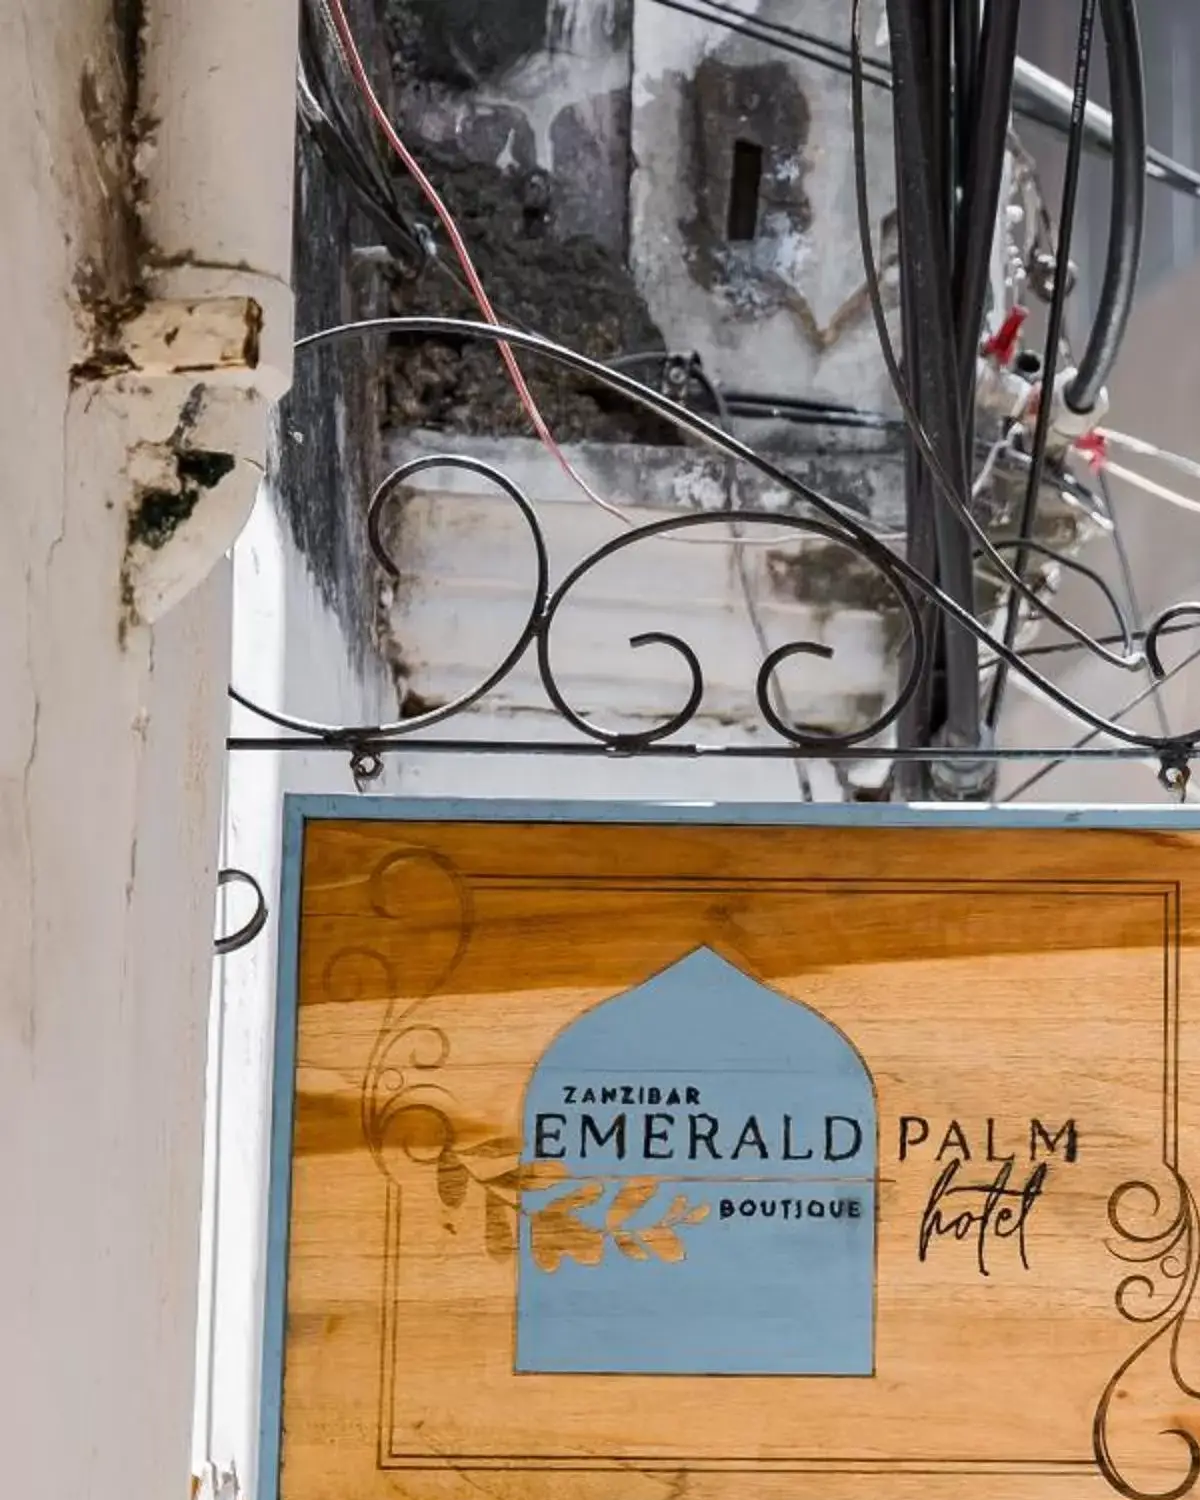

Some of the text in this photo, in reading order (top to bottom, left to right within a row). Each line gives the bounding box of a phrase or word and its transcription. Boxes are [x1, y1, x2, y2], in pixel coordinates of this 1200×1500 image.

[563, 1085, 701, 1105] ZANZIBAR
[534, 1112, 1079, 1163] EMERALD PALM
[719, 1198, 862, 1220] BOUTIQUE
[918, 1157, 1048, 1277] hotel
